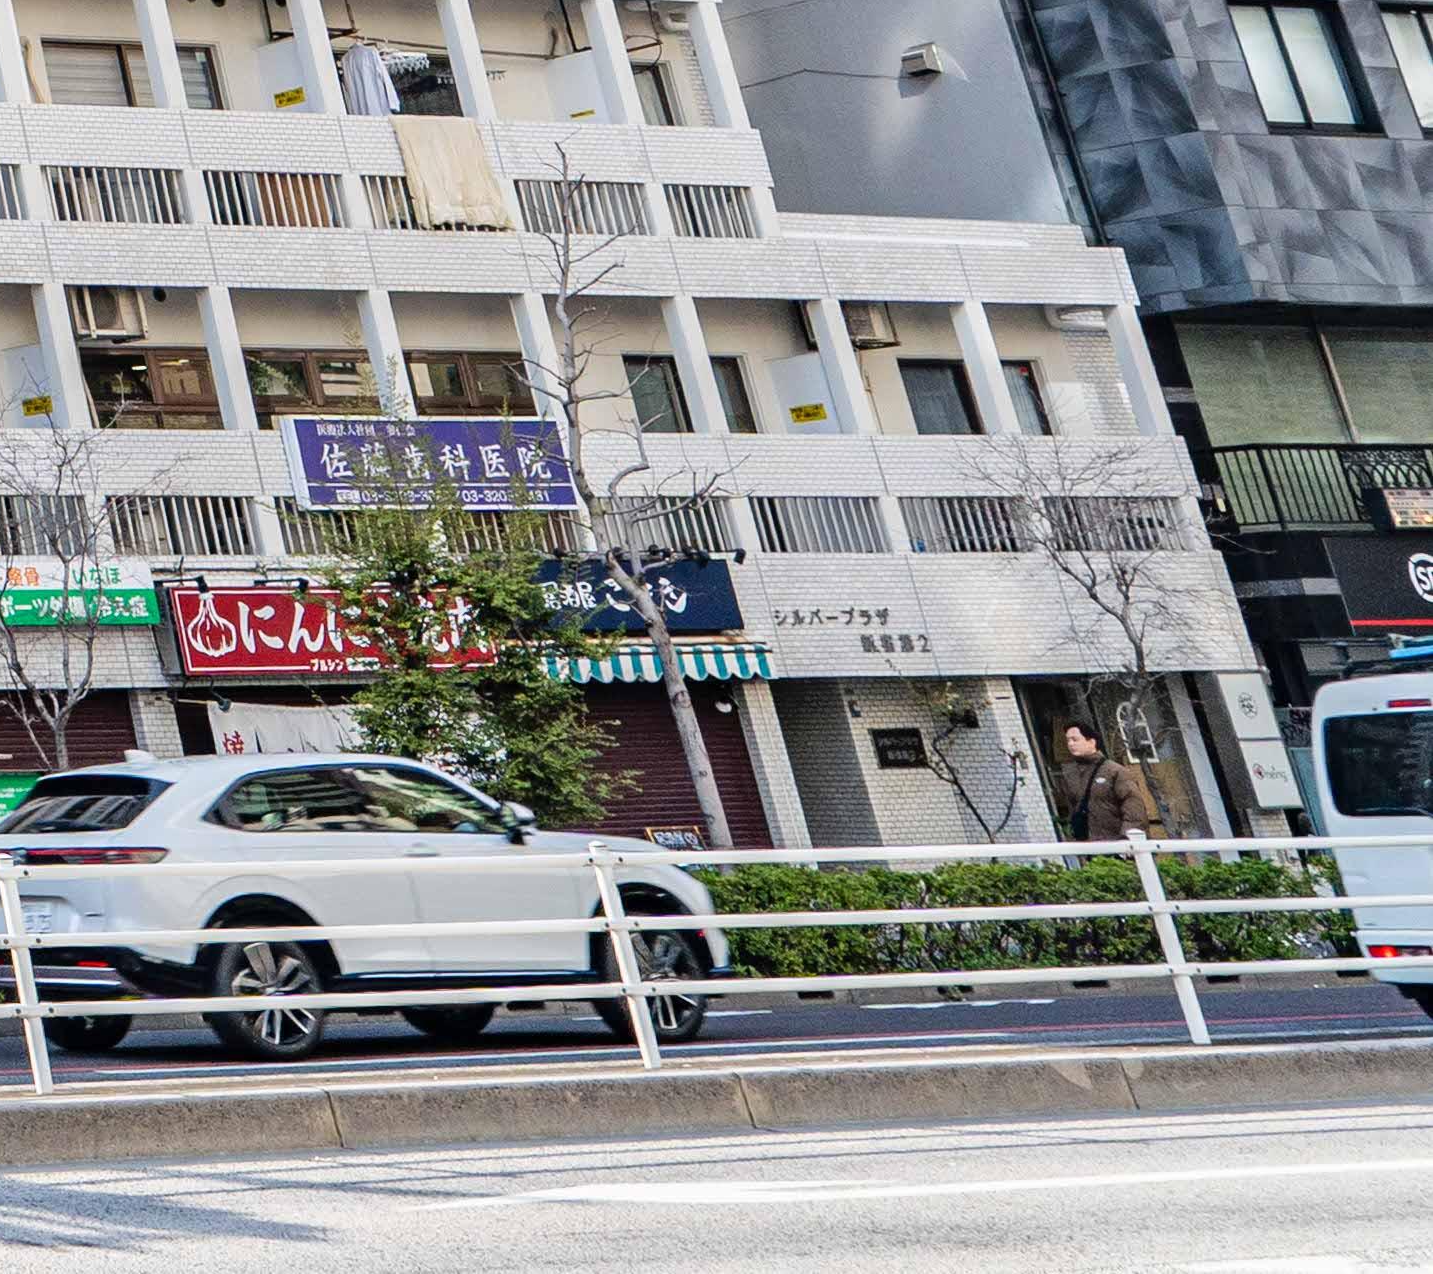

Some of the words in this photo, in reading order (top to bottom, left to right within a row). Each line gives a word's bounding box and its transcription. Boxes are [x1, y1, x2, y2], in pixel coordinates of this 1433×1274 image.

[72, 565, 122, 585] いなほ
[774, 606, 890, 627] シルバープラザ
